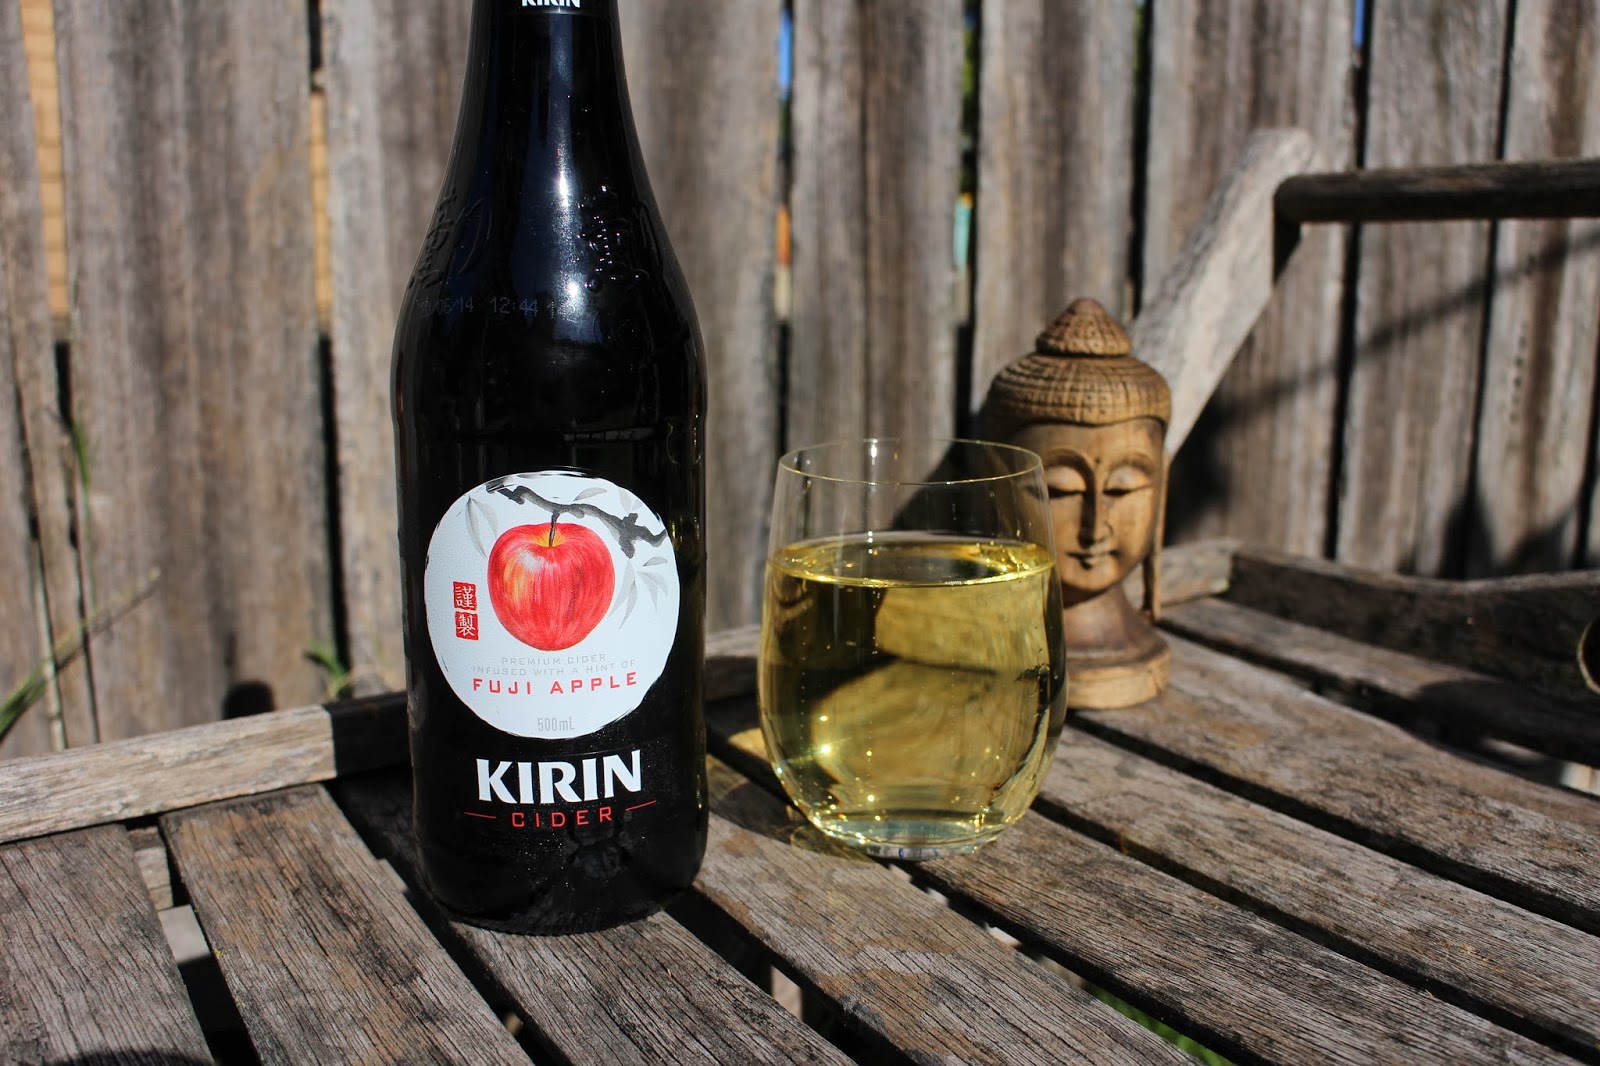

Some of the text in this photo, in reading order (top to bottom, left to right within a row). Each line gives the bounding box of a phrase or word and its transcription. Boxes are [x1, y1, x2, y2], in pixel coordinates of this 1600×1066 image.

[490, 295, 539, 317] 12:44
[454, 584, 477, 638] 謹製
[472, 659, 636, 676] INFUSED WITH A HINT OF
[501, 653, 606, 666] PREMIUM CIDER
[472, 671, 637, 695] FUJI APPLE
[537, 717, 575, 732] 500mL
[476, 749, 642, 804] KIRIN
[511, 806, 613, 828] CIDER
